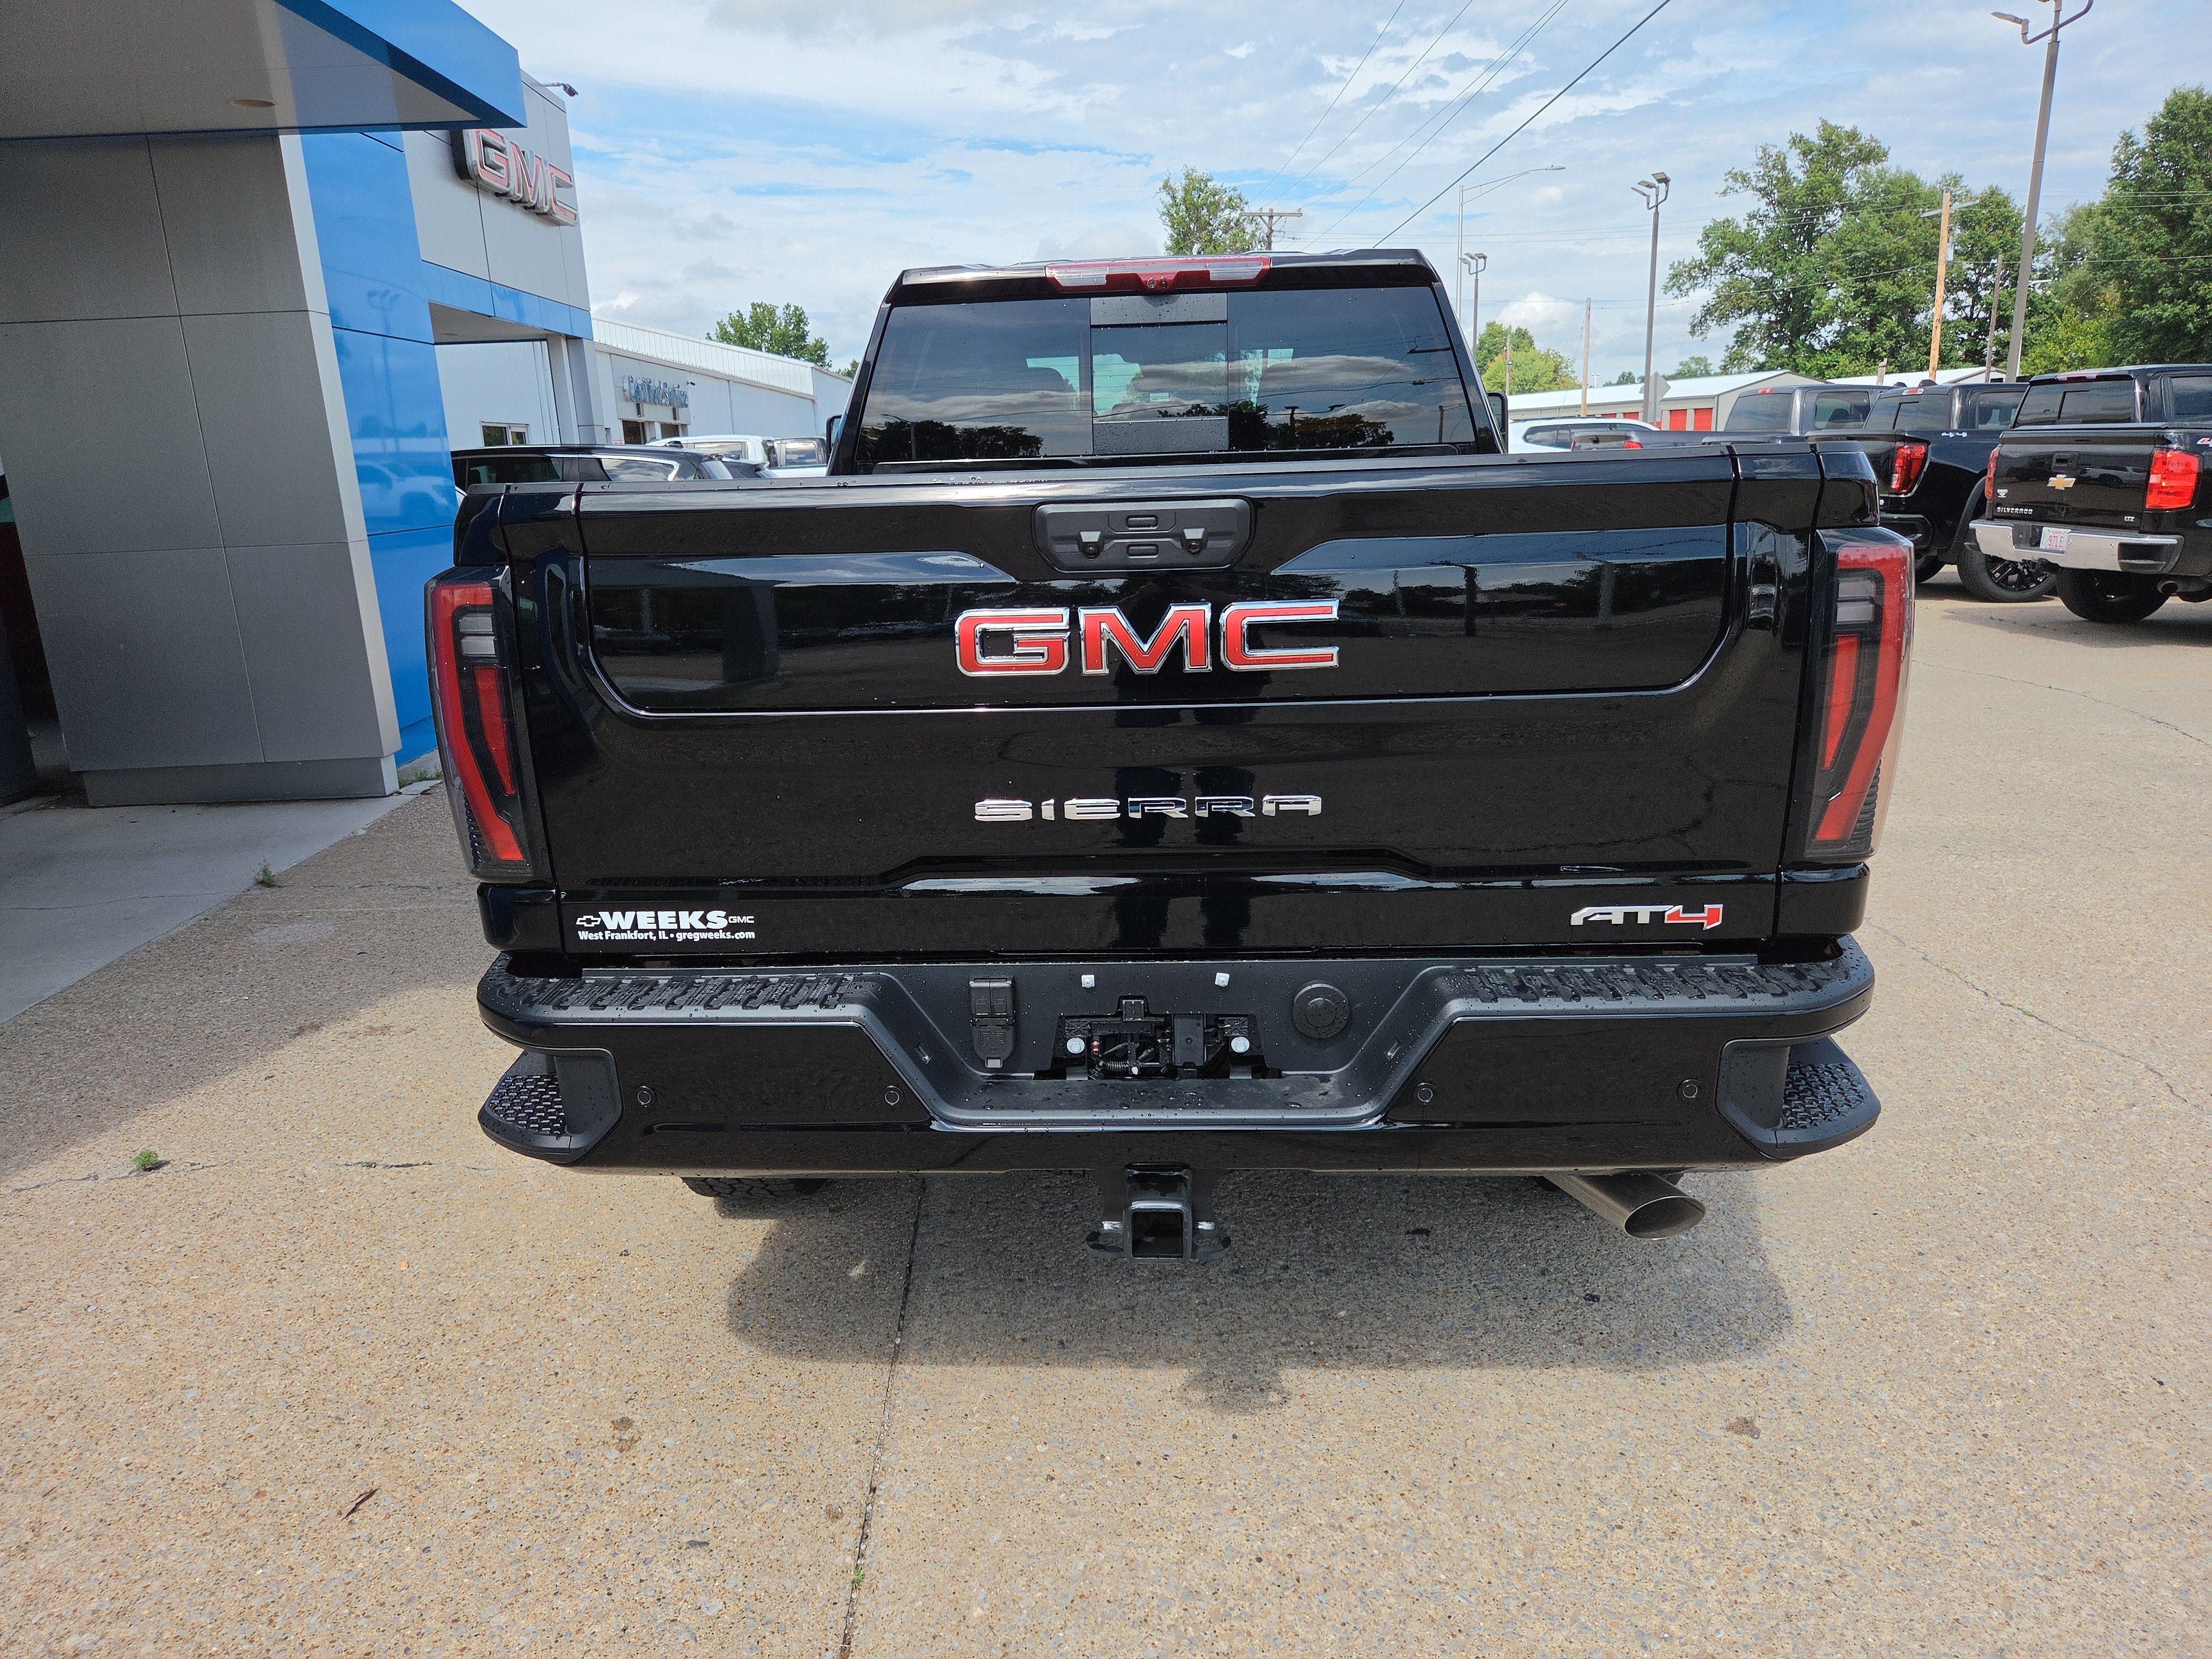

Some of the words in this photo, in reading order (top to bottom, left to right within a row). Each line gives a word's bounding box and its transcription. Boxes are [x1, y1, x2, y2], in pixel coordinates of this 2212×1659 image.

[465, 128, 578, 226] GMC
[1997, 506, 2033, 515] SILVERADO
[954, 599, 1339, 677] GMC
[975, 795, 1321, 821] SIERRA
[599, 910, 728, 929] WEEKS
[728, 916, 755, 924] GMC
[1571, 904, 1724, 930] AT4
[578, 931, 603, 940] West
[605, 930, 657, 941] Frankfort,
[659, 931, 668, 940] IL
[676, 930, 755, 942] gregweeks.com
